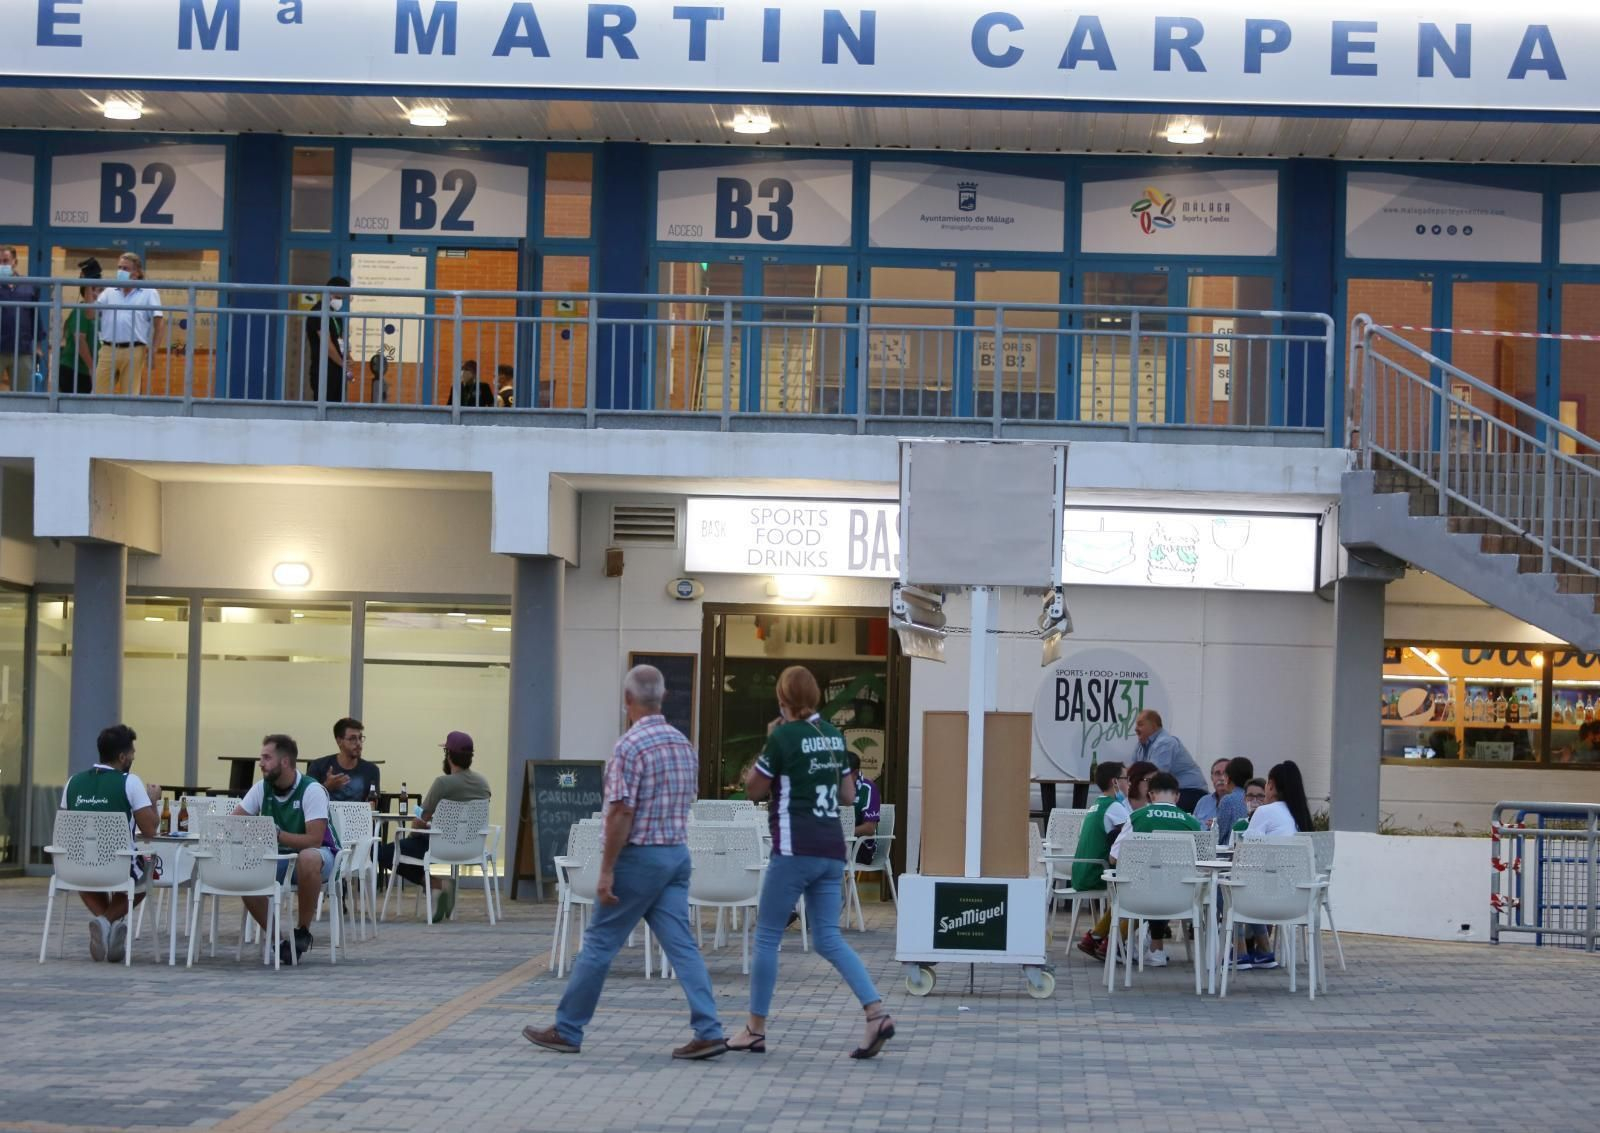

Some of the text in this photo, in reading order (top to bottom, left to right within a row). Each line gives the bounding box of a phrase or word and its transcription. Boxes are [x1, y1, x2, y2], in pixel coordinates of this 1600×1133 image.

[36, 0, 83, 47] E
[970, 11, 1568, 81] CARPENA
[54, 162, 177, 225] ACCESO B2
[354, 168, 478, 232] ACCESO B2
[667, 176, 794, 242] ACCESO B3
[919, 213, 973, 224] Ayuntamiento
[974, 215, 985, 223] de
[750, 507, 828, 527] SPORTS
[756, 528, 821, 546] FOOD
[747, 549, 828, 568] DRINKS
[1055, 669, 1149, 679] SPORTS FOOD DRINKS
[1054, 677, 1150, 724] BASK3T
